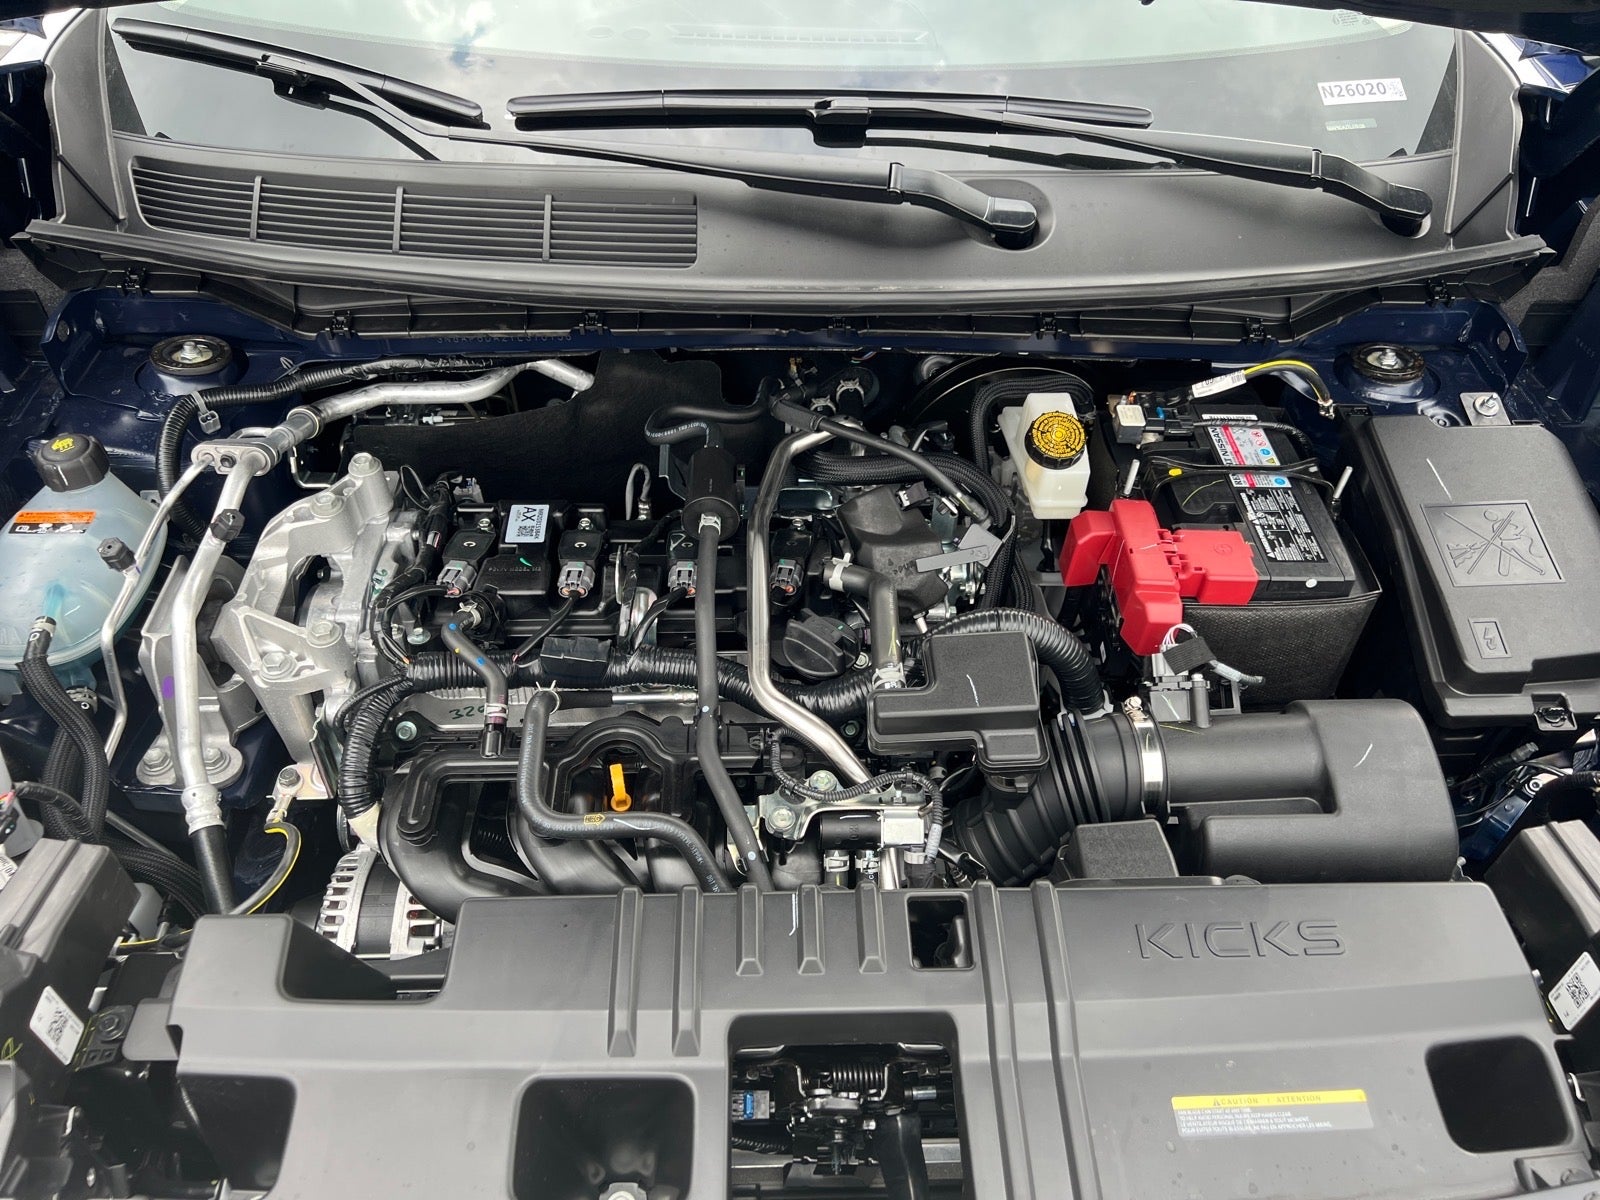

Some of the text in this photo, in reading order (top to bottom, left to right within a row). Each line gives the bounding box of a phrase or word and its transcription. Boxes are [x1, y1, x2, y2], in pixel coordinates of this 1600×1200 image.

[1321, 82, 1387, 98] N26020
[1210, 427, 1229, 456] NISSAN
[521, 506, 537, 522] AX
[1135, 920, 1346, 959] KICKS
[1222, 1097, 1259, 1105] CAUTION
[1276, 1094, 1322, 1103] ATTENTION
